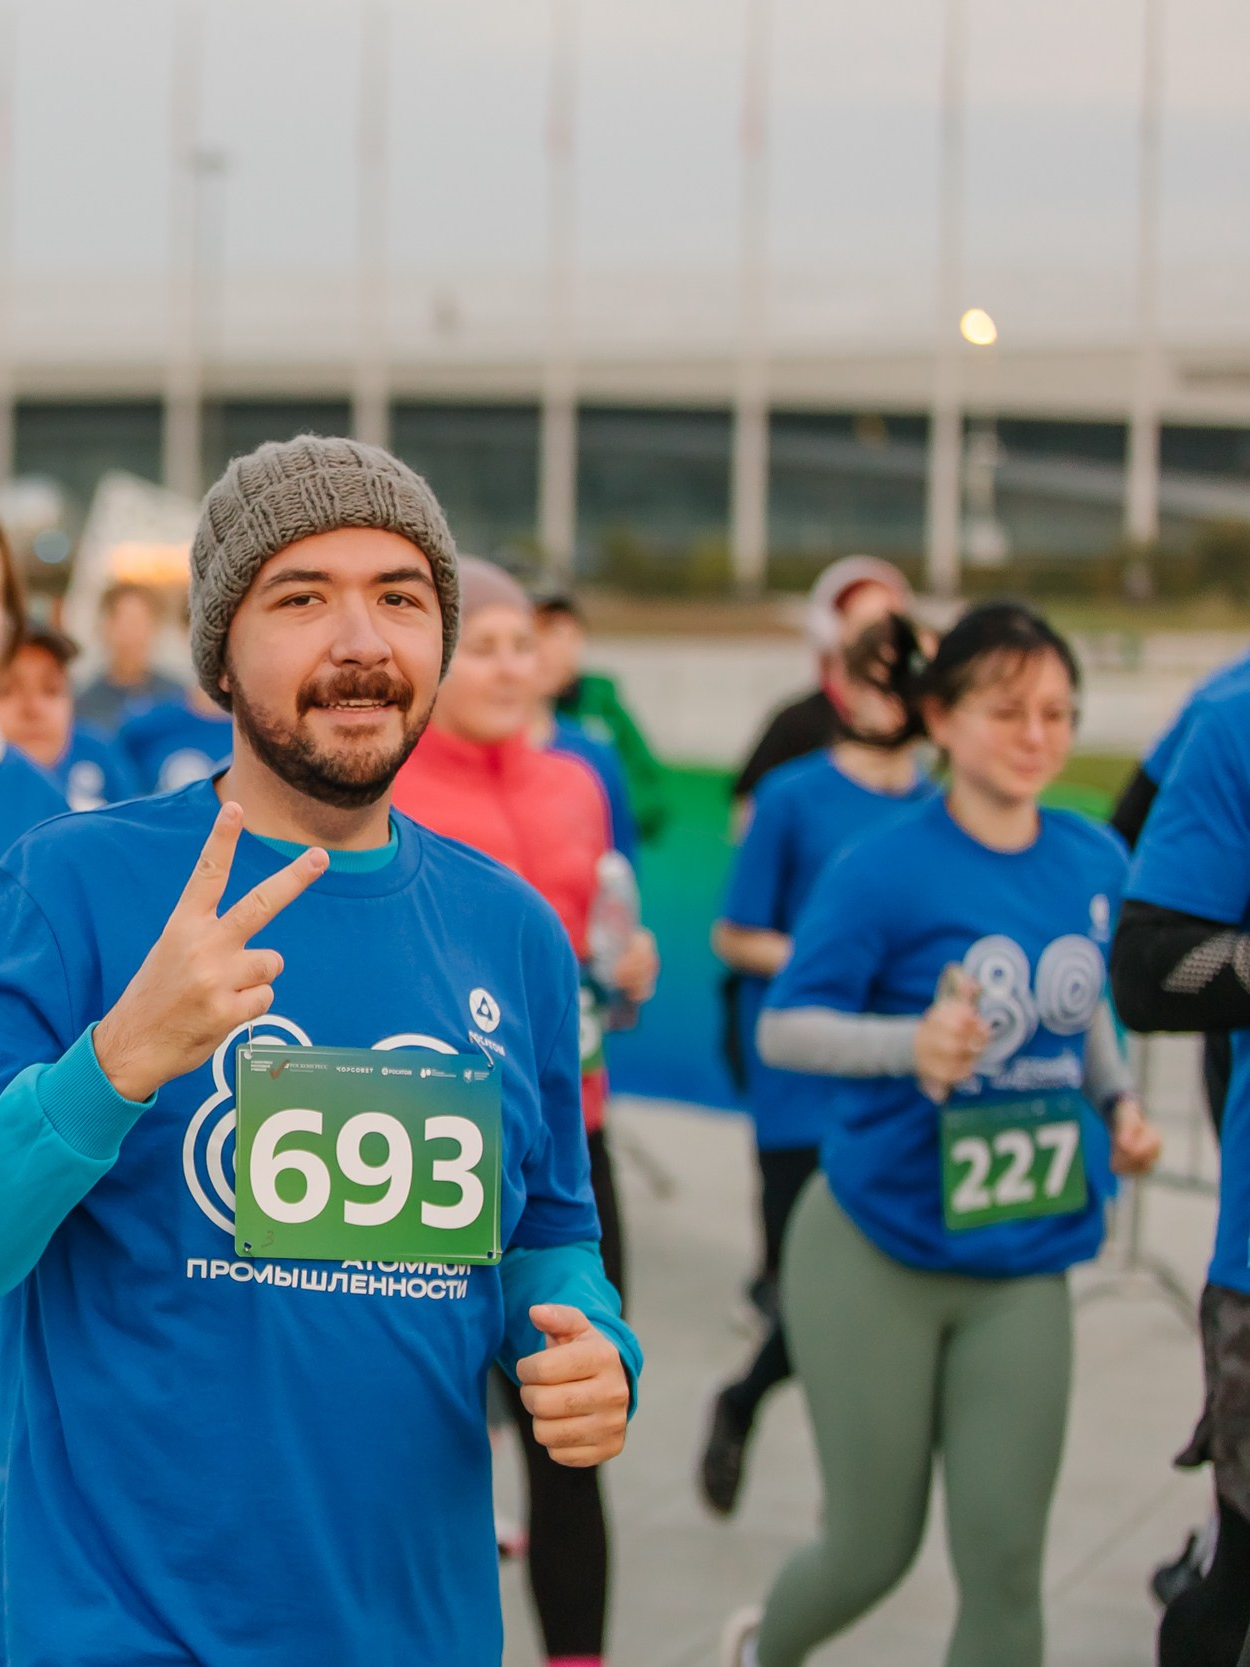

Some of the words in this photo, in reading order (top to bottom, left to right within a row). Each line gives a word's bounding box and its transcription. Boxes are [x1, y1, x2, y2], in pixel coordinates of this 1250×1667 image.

[249, 1108, 485, 1230] 693
[951, 1121, 1080, 1213] 227
[186, 1258, 468, 1300] ПРОМЫШЛЕННОСТИ
